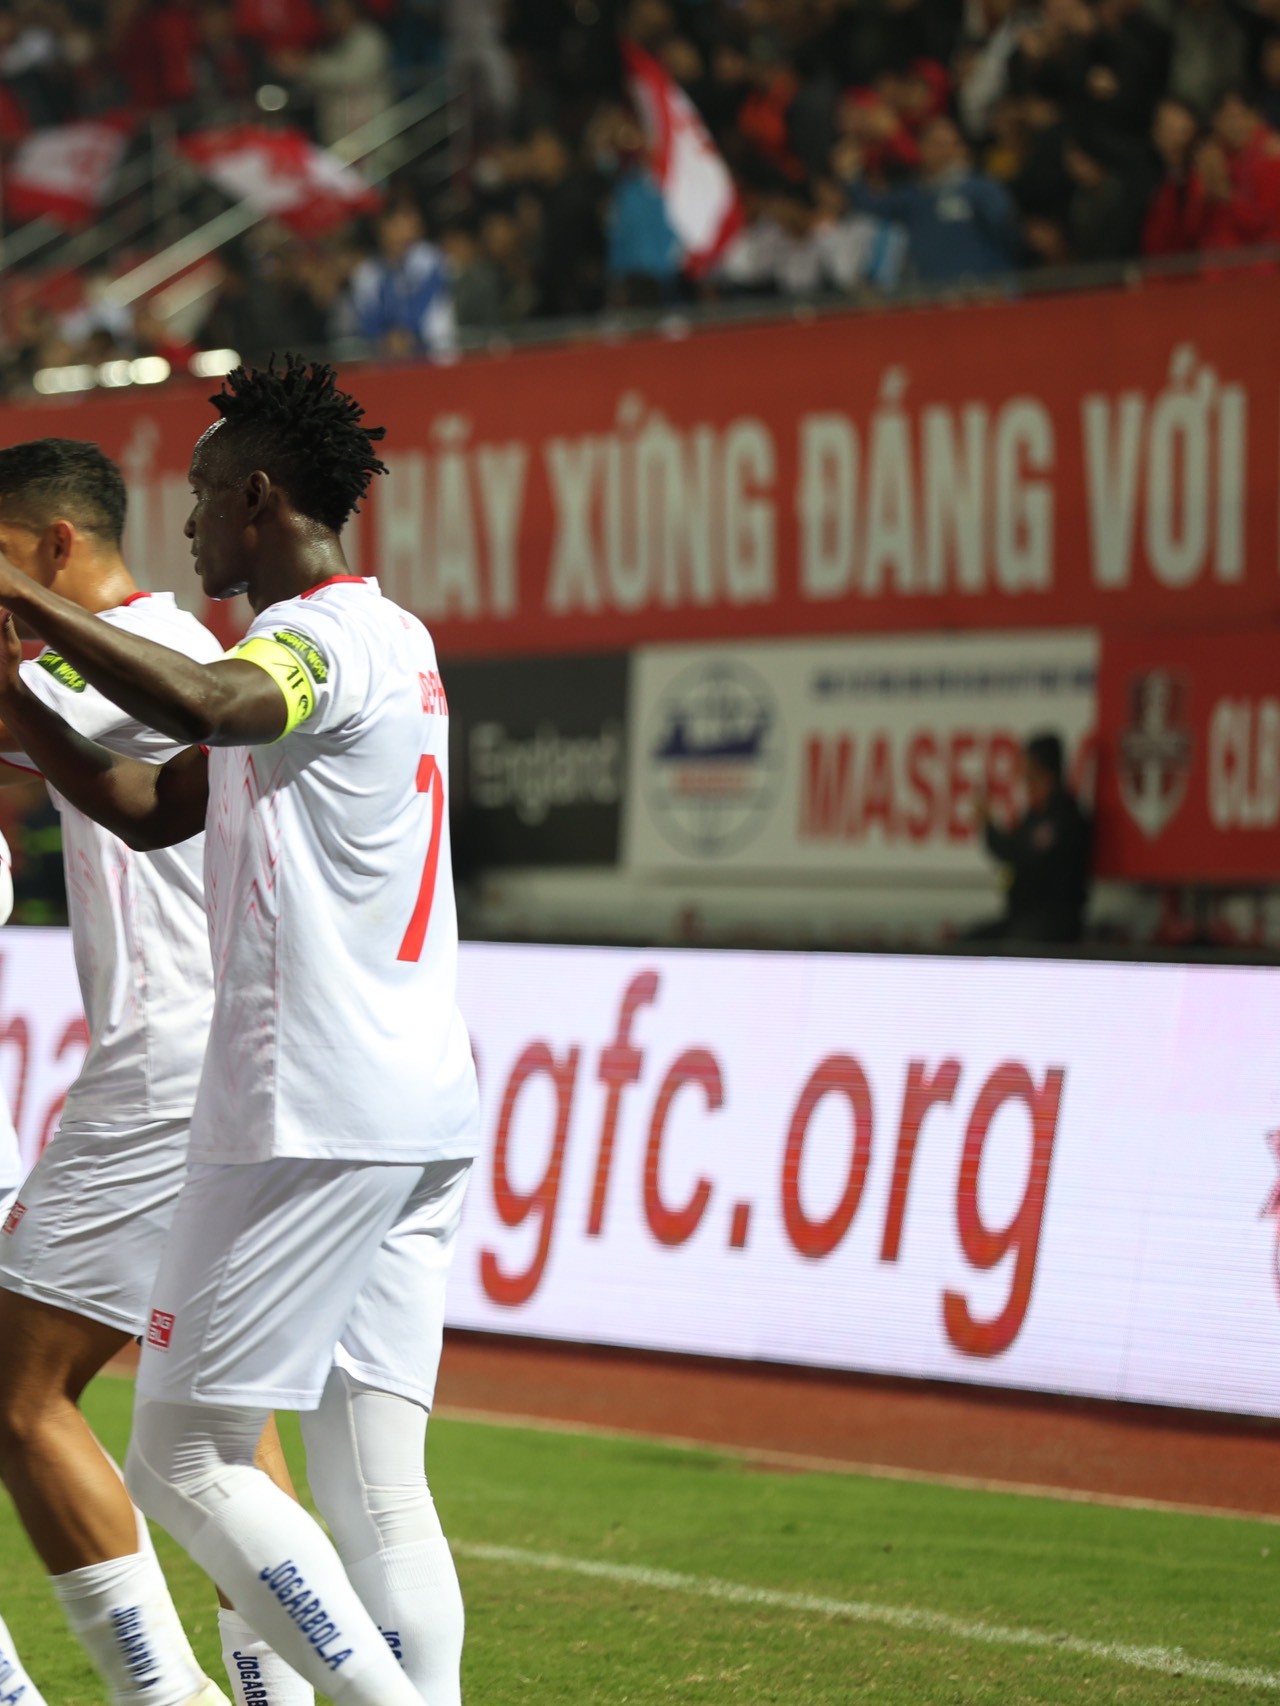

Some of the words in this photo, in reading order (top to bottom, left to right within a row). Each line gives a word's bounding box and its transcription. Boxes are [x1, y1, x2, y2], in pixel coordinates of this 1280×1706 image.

[796, 364, 1055, 599] ĐÁNG
[1083, 342, 1247, 588] VỚI
[396, 754, 444, 962] 7
[473, 969, 1067, 1359] gfc.org
[258, 1559, 354, 1672] JOGARBOLA
